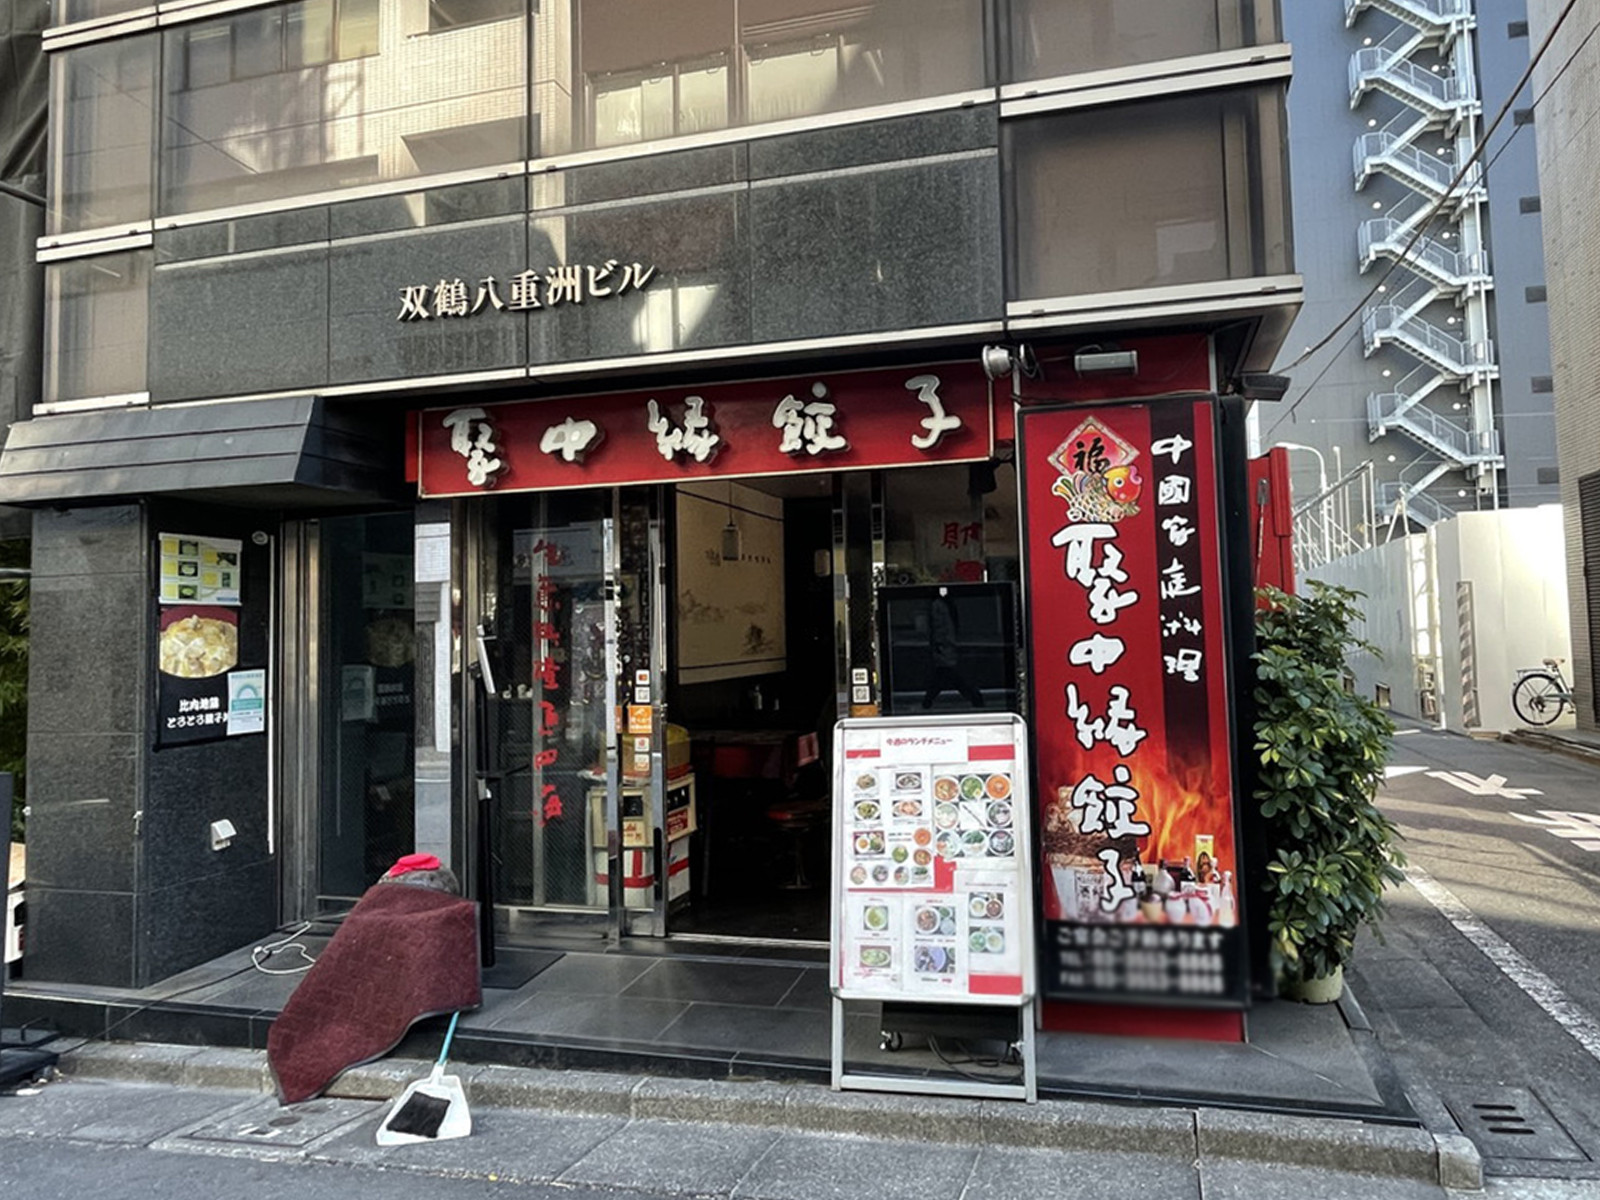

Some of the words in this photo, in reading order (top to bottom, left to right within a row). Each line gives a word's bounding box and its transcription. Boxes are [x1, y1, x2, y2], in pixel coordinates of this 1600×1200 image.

[397, 259, 655, 321] 双鶴八重洲ビル
[1073, 437, 1111, 473] 福
